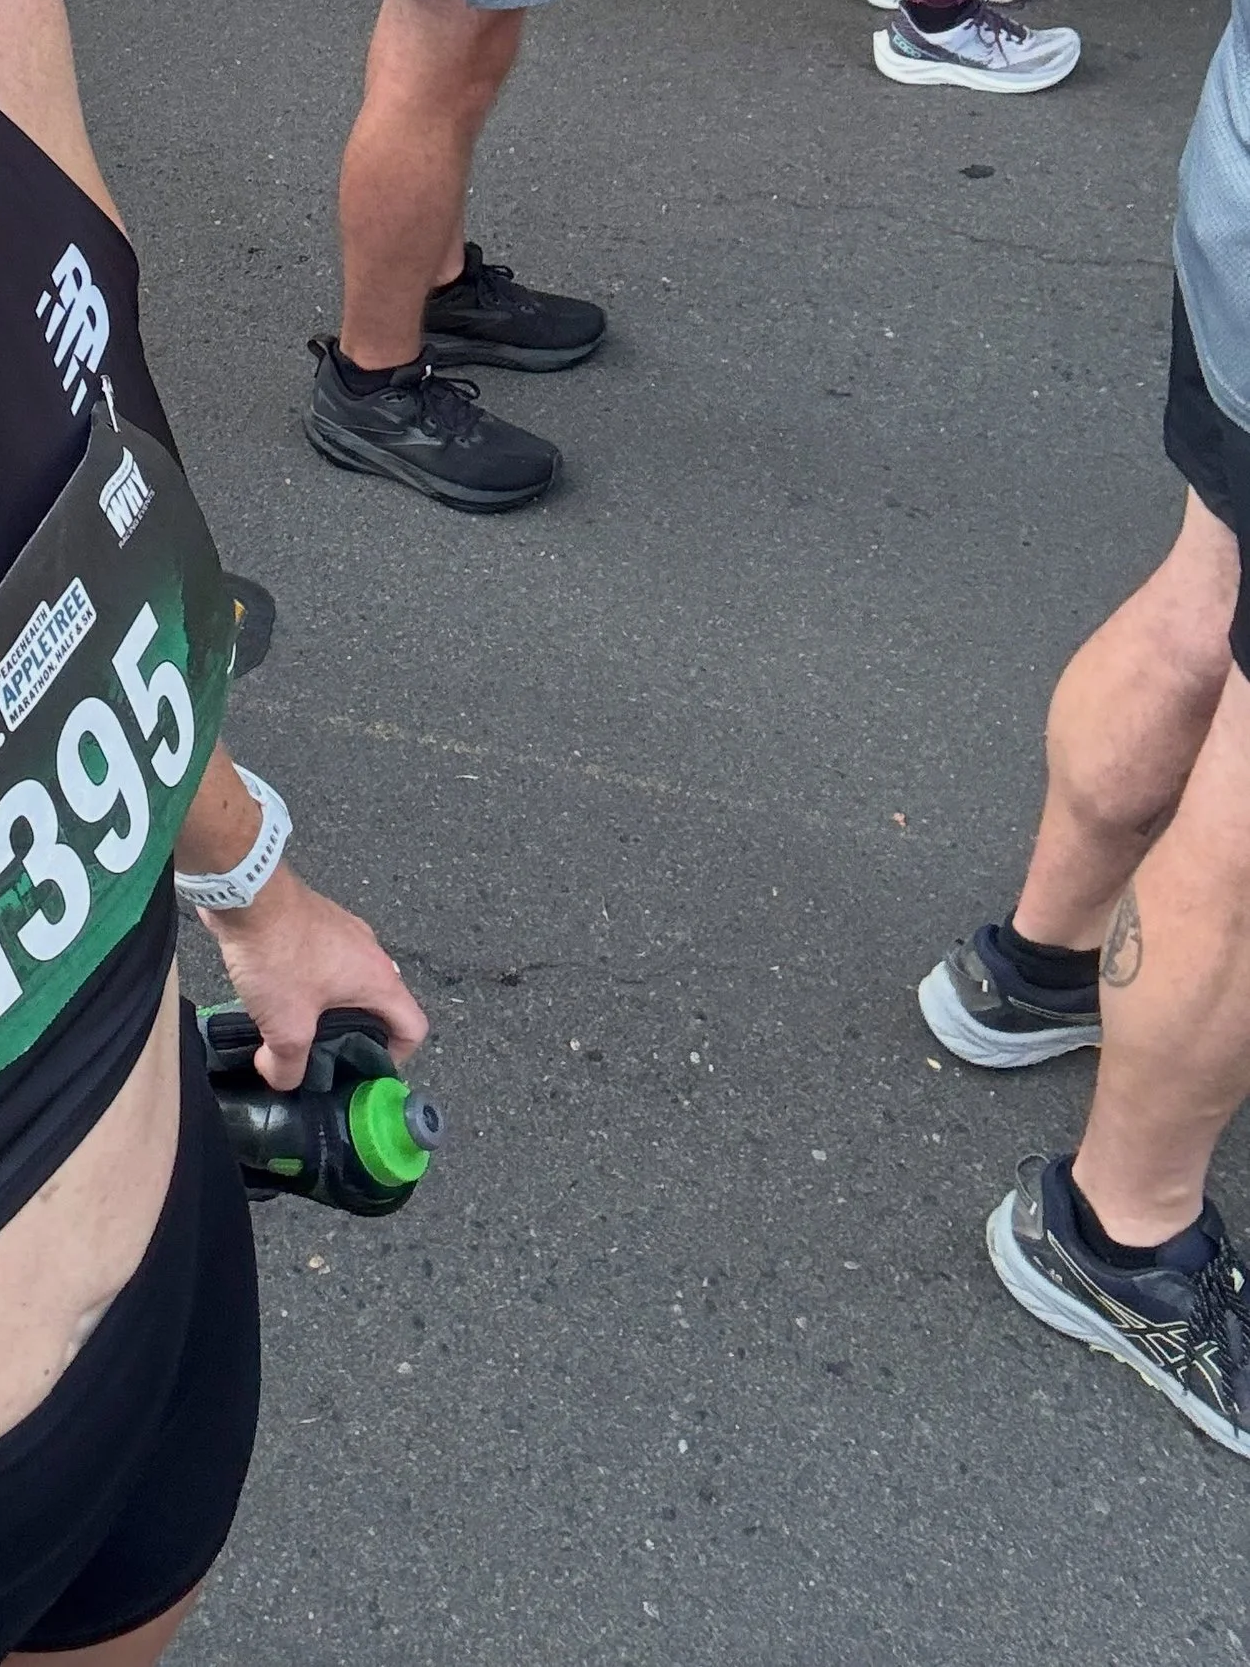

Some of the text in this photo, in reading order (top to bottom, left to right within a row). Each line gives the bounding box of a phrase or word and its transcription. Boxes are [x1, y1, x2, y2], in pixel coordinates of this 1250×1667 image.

[105, 460, 149, 539] WHY
[1, 584, 86, 710] APPLETREE
[8, 607, 94, 725] MARATHON, HALF & 5K
